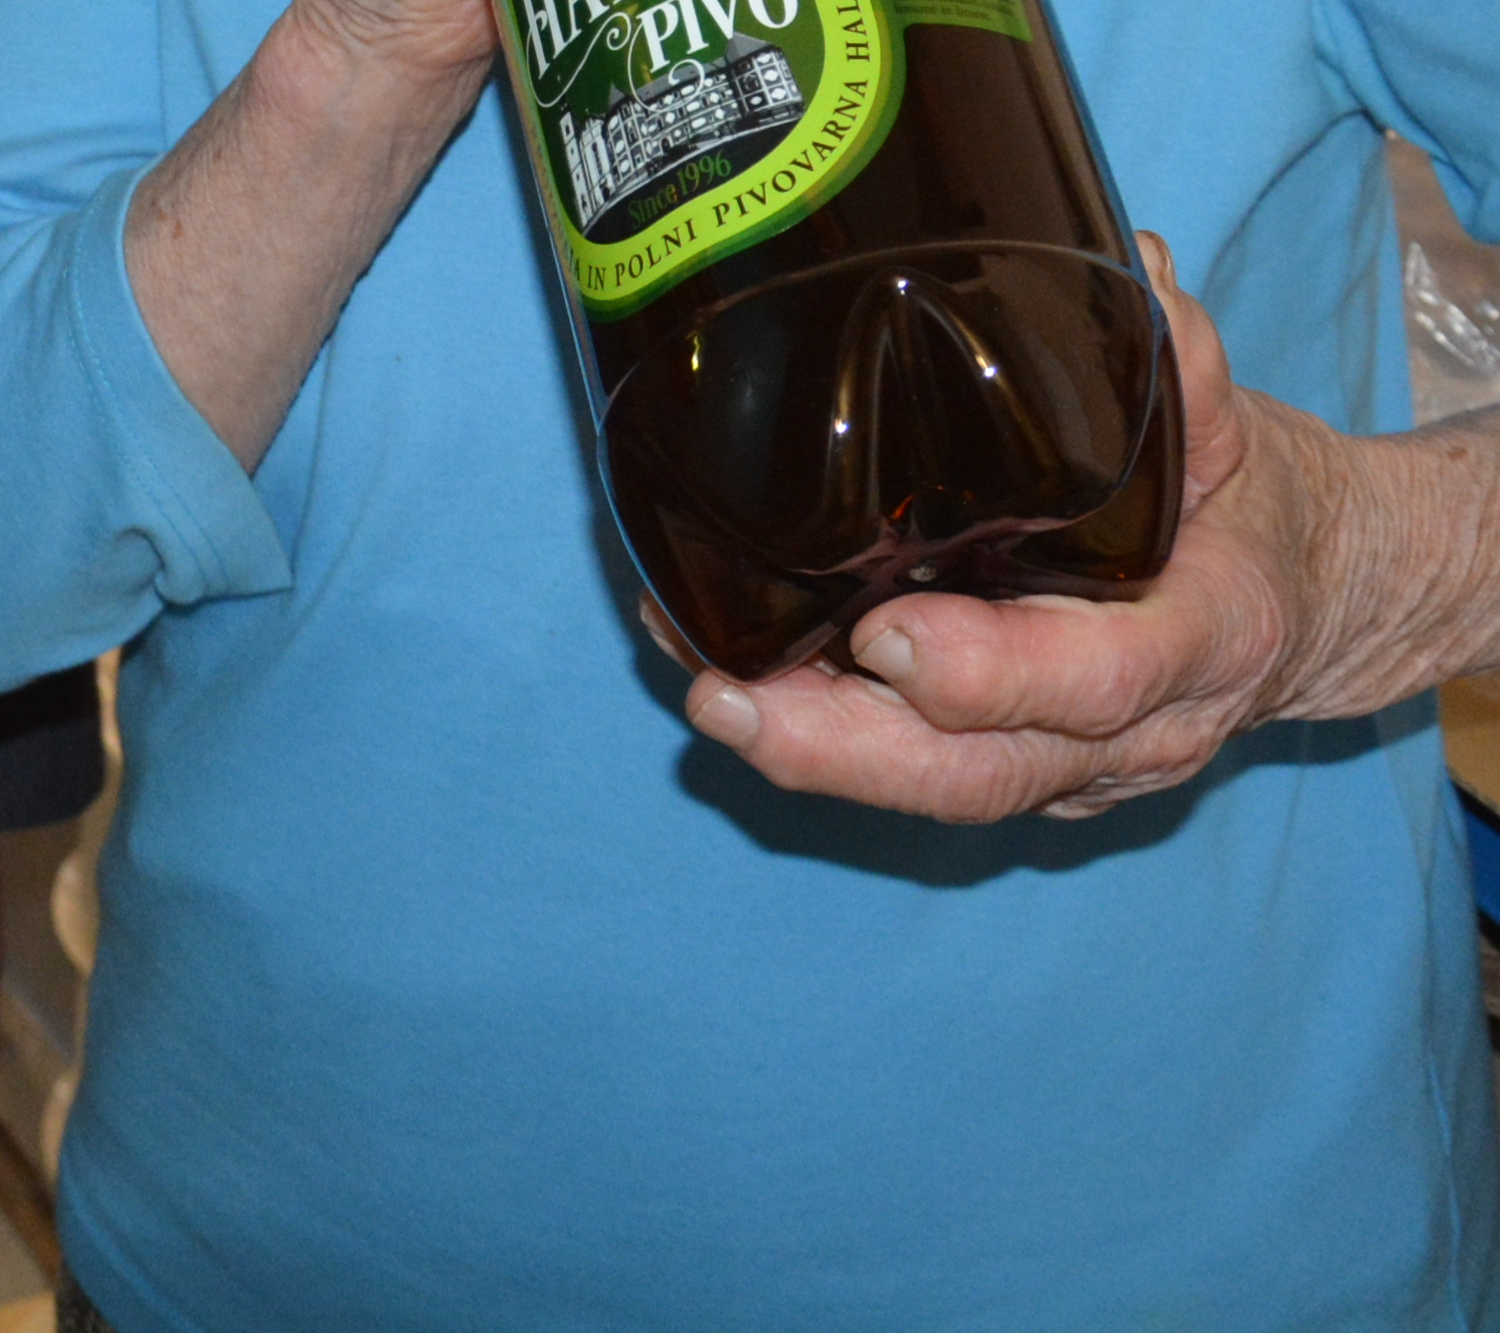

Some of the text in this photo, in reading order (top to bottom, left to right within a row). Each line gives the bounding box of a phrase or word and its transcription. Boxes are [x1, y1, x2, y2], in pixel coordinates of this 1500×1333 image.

[586, 264, 607, 291] IN
[614, 217, 699, 287] POLNI
[712, 78, 869, 228] PIVOVARNA
[628, 148, 733, 230] Since 1996
